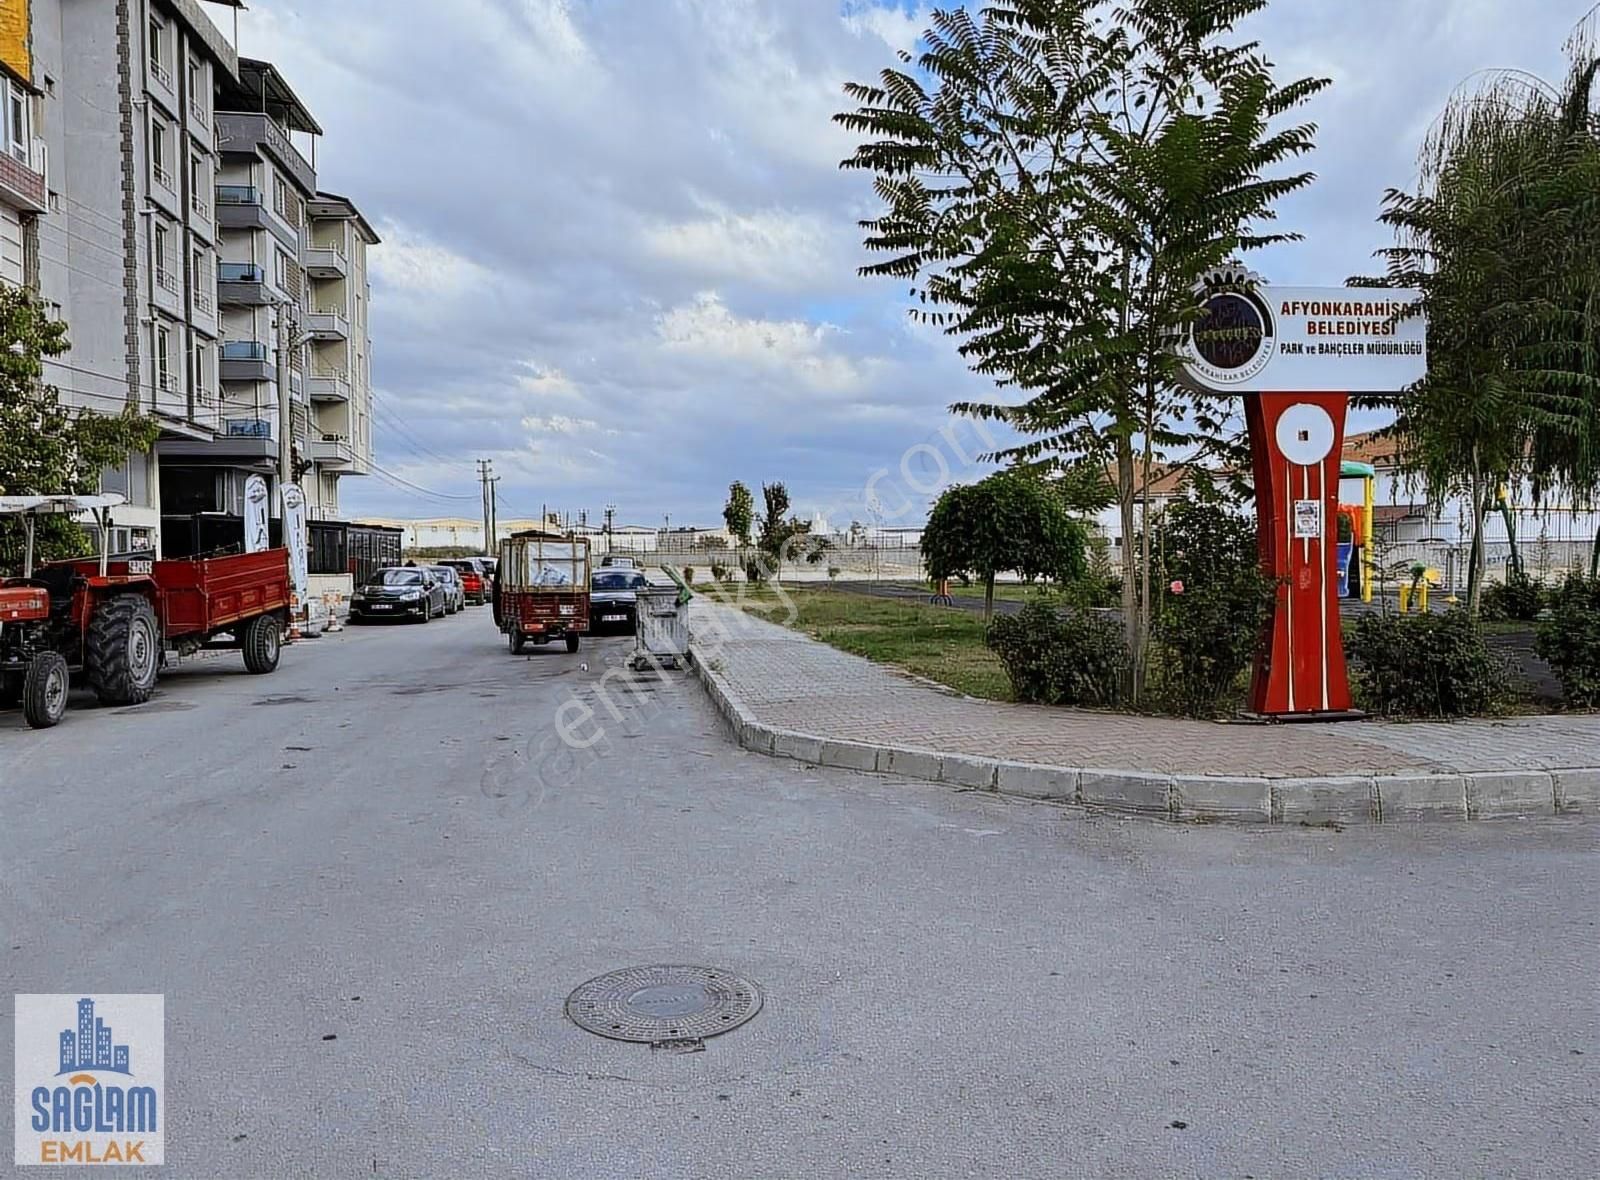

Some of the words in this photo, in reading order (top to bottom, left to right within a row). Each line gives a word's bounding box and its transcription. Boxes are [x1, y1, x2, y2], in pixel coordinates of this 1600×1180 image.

[1307, 317, 1396, 336] BELEDİYESİ
[1280, 342, 1304, 355] PARK
[1306, 345, 1316, 355] ve
[1318, 342, 1364, 358] BAHÇELER
[1366, 340, 1422, 355] MÜDÜRLÜĞÜ
